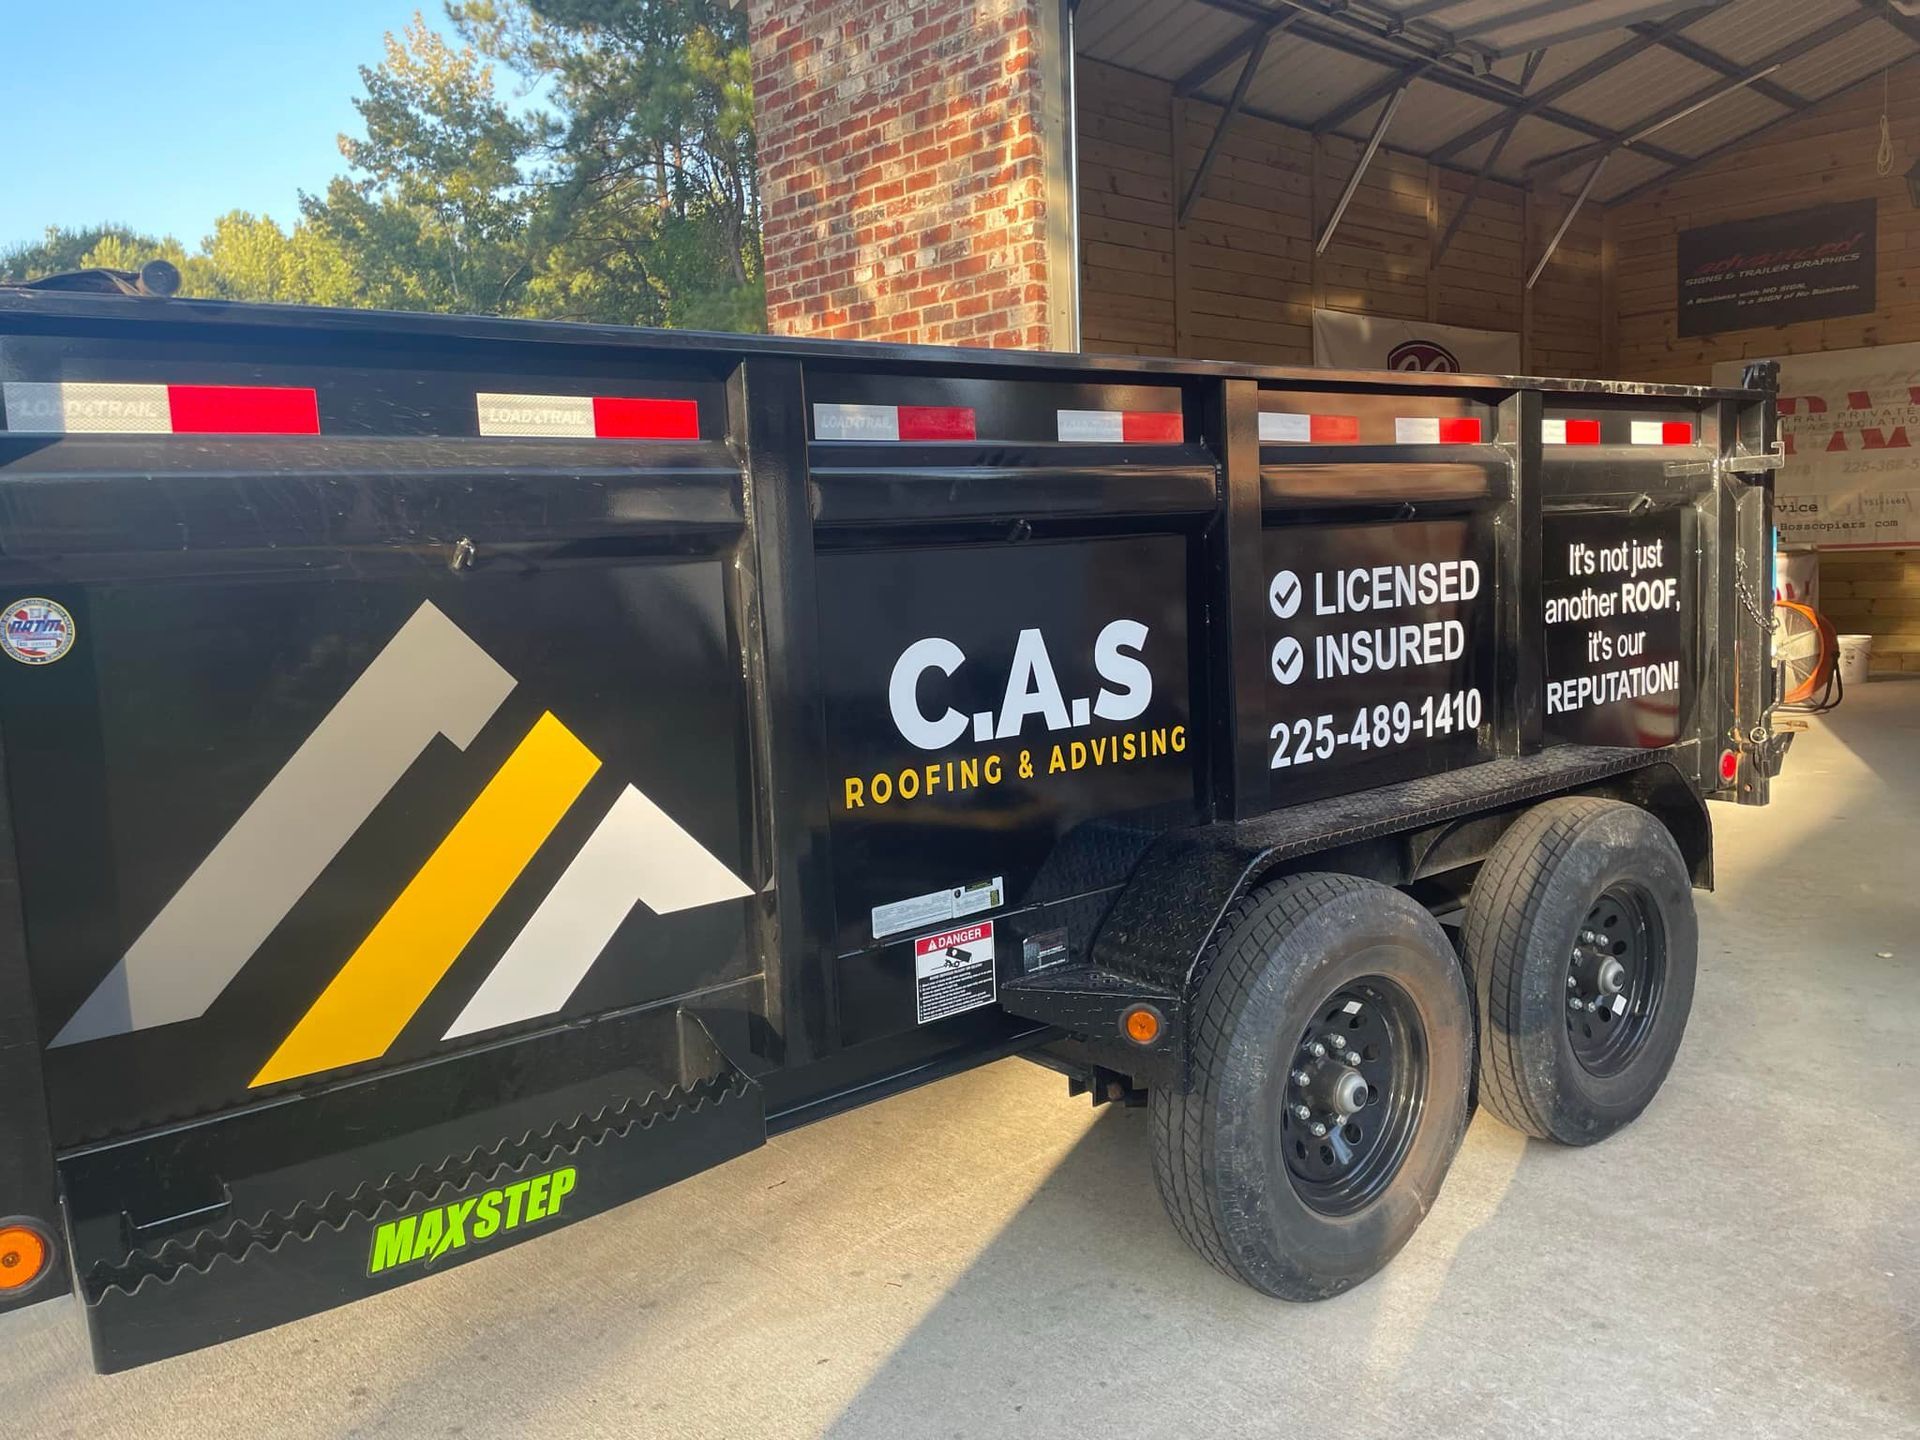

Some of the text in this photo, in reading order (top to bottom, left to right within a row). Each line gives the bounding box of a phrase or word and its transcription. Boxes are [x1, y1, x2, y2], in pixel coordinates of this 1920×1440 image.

[1685, 274, 1723, 287] SIGNS
[1740, 263, 1791, 279] TRAILER
[1792, 252, 1860, 270] GRAPHICS
[1837, 406, 1916, 421] PRIVATE
[1569, 538, 1663, 578] It's not just
[1315, 560, 1480, 616] LICENSED
[1545, 577, 1680, 624] another ROOF,
[1315, 619, 1465, 680] INSURED
[1588, 630, 1647, 663] it's our
[888, 619, 1153, 750] C.A.S
[1546, 660, 1679, 715] REPUTATION!
[1270, 688, 1482, 770] 225-489-1410
[844, 725, 1187, 810] ROOFING & ADVISING
[938, 928, 982, 948] DANGER
[371, 1167, 576, 1274] MAXSTEP
